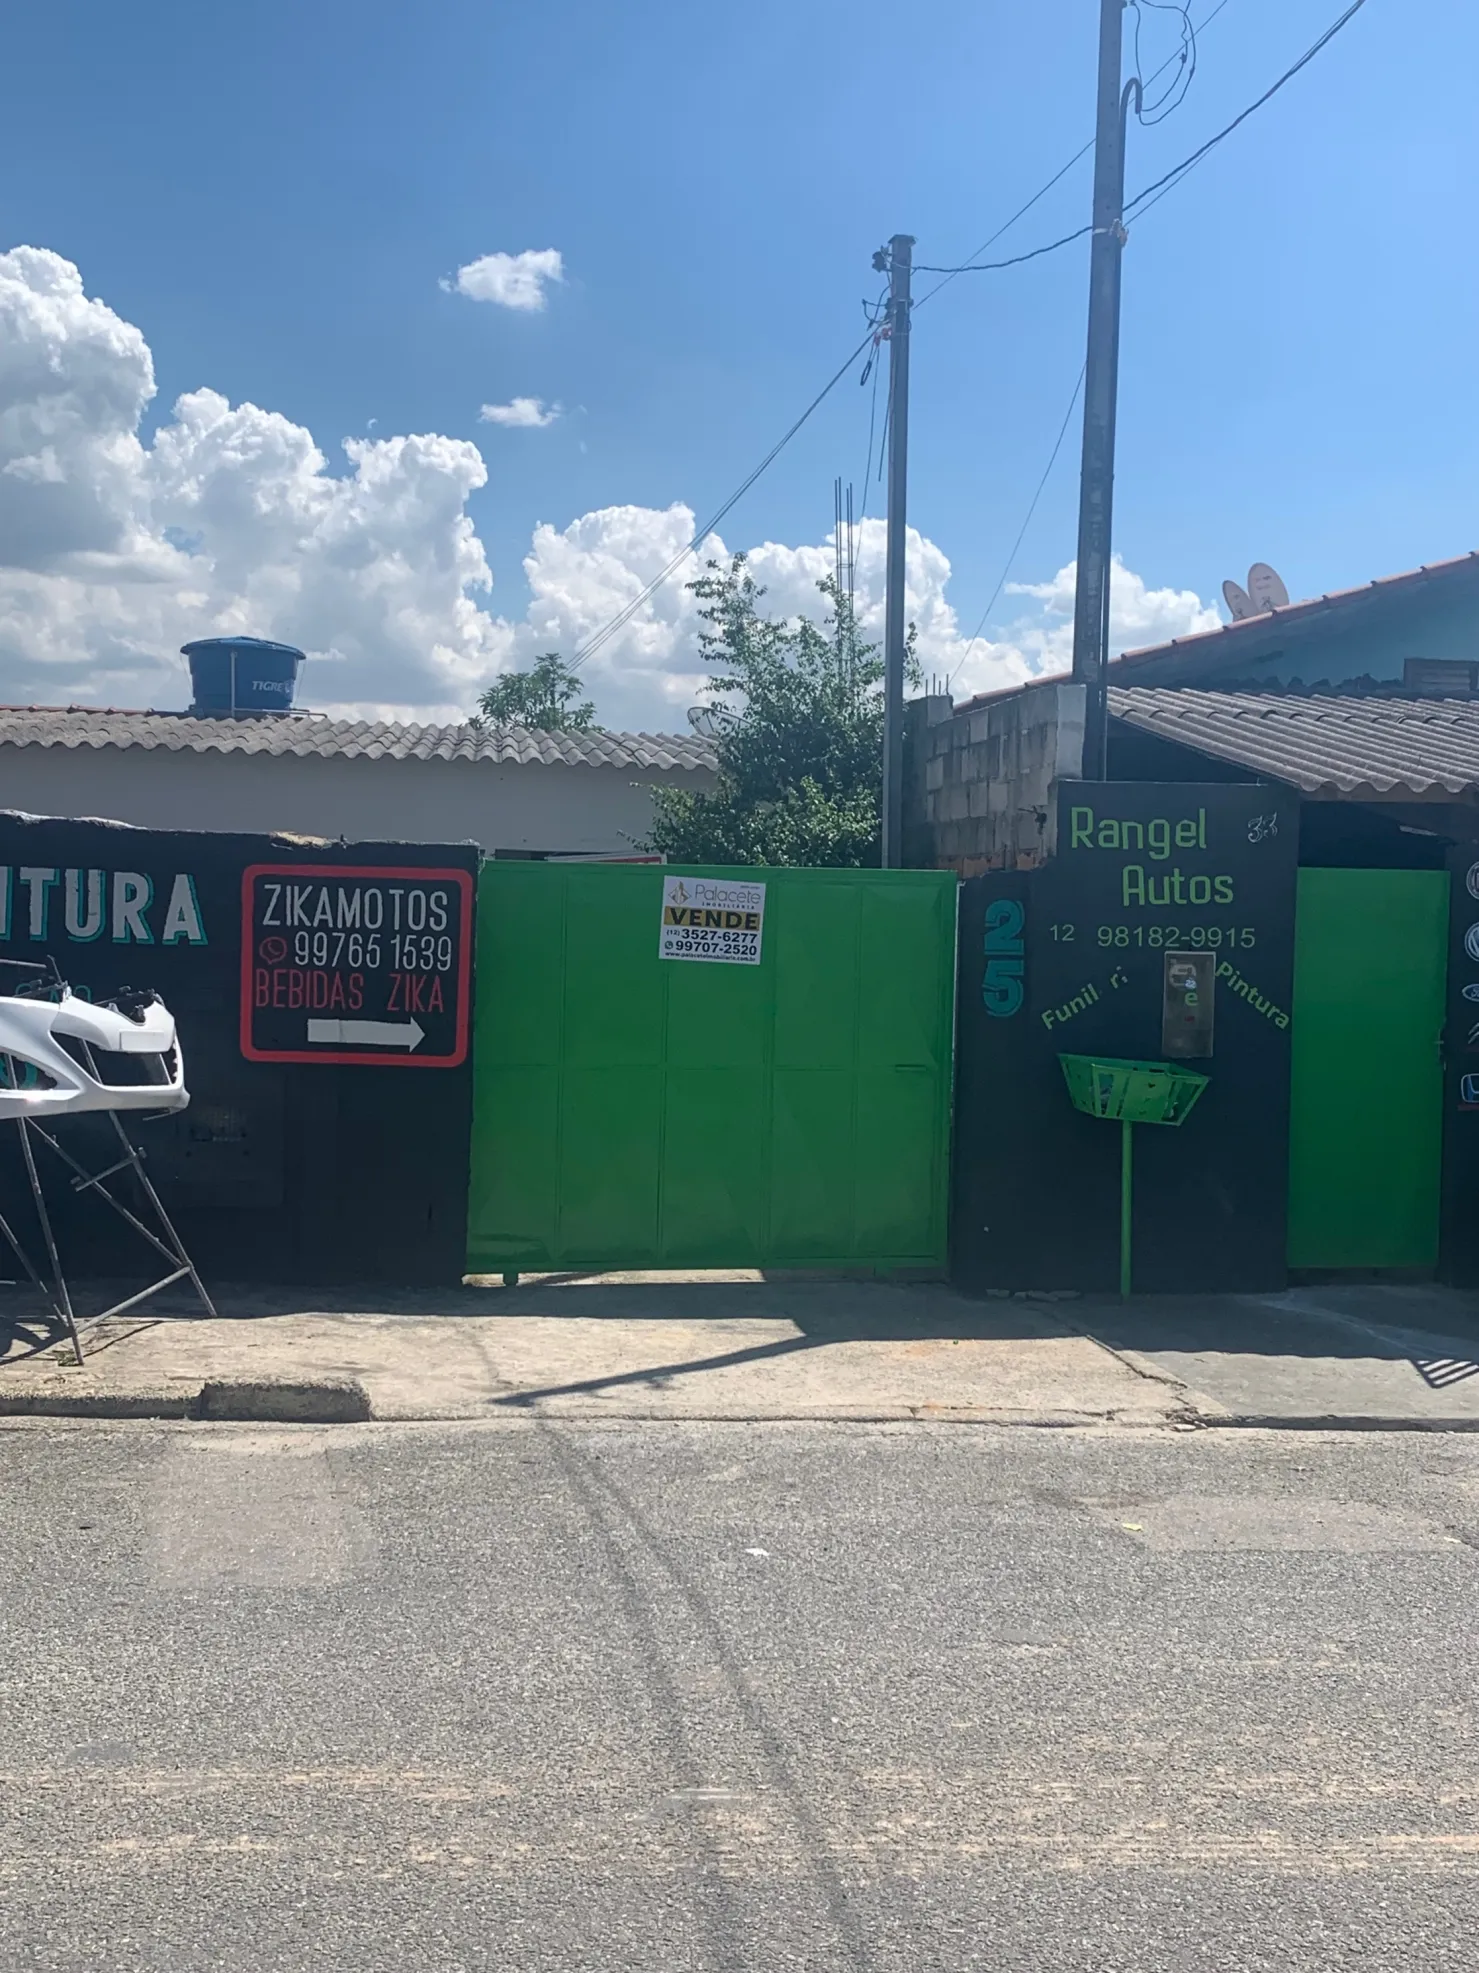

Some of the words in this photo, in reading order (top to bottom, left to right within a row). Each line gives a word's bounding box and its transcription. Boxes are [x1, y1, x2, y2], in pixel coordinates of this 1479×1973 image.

[252, 681, 282, 692] TIGRE
[1070, 807, 1207, 860] Rangel
[695, 884, 761, 904] Palacete
[1122, 865, 1234, 906] Autos
[670, 908, 758, 930] VENDE
[676, 941, 757, 956] 99707-2520
[681, 928, 758, 944] 3527-6277
[1050, 924, 1075, 941] 12
[1097, 926, 1256, 949] 98182-9915
[293, 931, 380, 968] 99765
[390, 934, 452, 971] 1539
[255, 968, 364, 1010] BEBIDAS
[387, 973, 444, 1013] ZIKA
[1215, 961, 1290, 1029] Pintura
